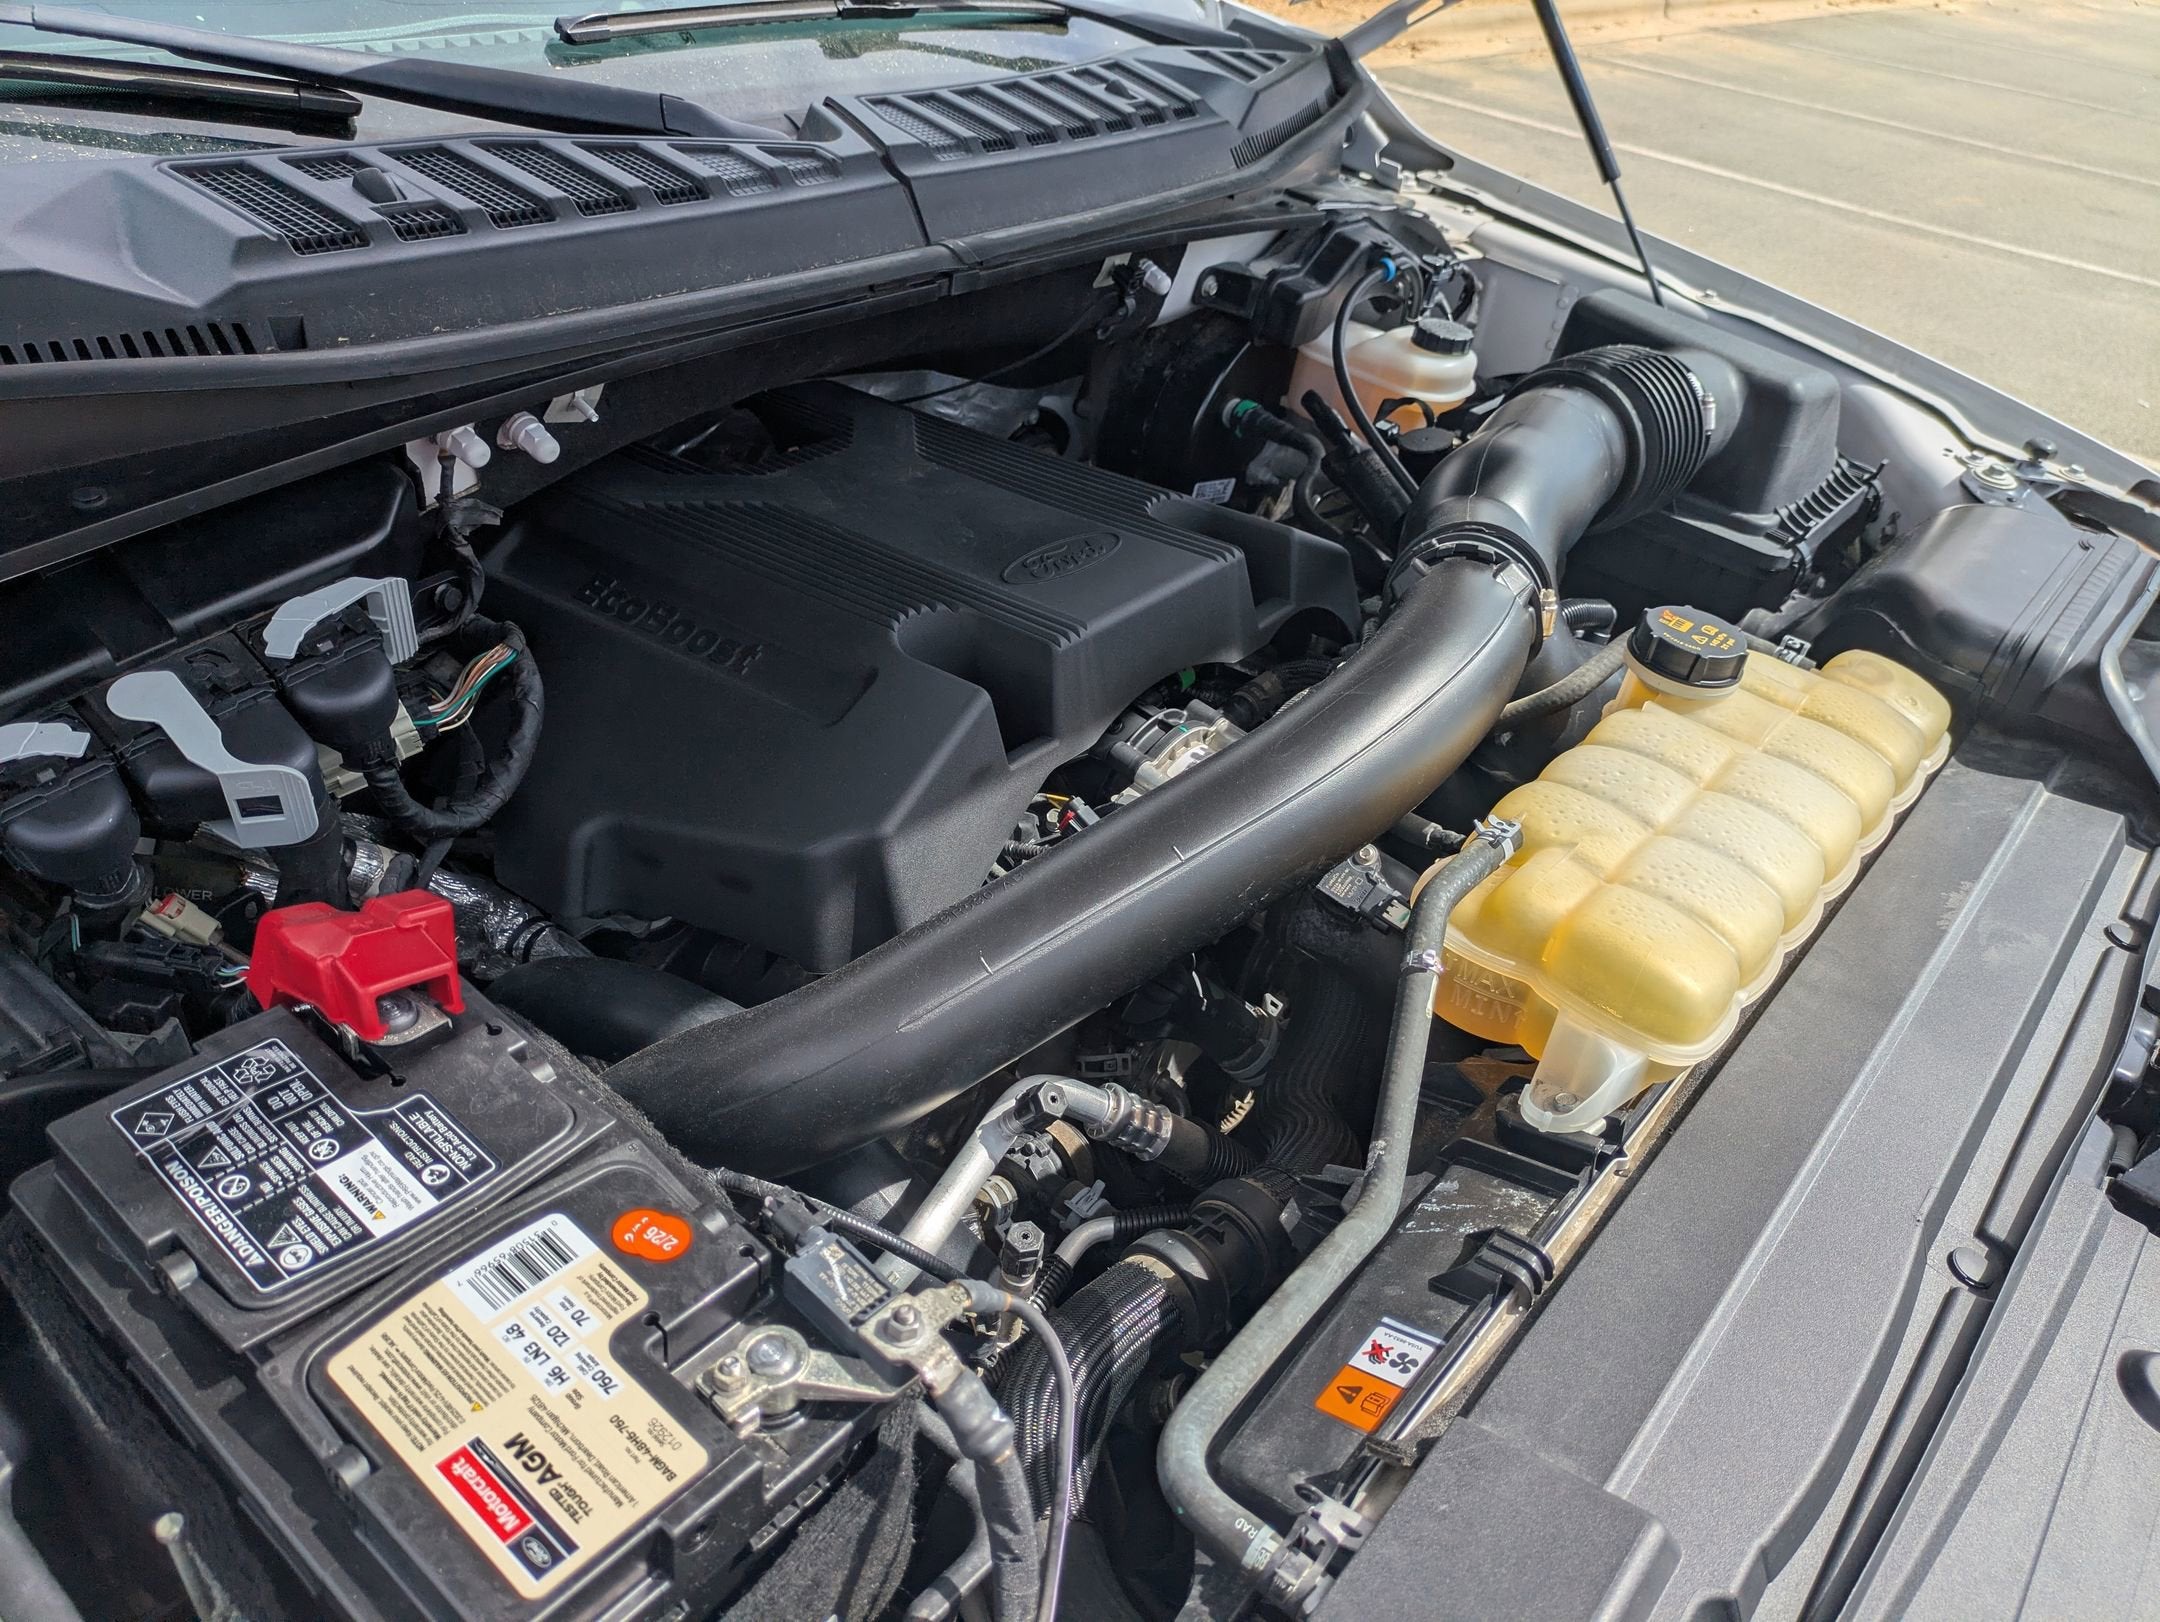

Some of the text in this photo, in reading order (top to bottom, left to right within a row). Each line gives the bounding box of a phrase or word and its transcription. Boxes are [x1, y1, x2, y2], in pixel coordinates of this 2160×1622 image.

[1022, 540, 1107, 578] Ford
[579, 580, 763, 675] EcoBoost
[1457, 961, 1515, 998] MAX
[1451, 985, 1511, 1023] MIN
[198, 1075, 230, 1106] GET MEDICAL
[212, 1075, 239, 1101] HELP FAST.
[277, 1087, 299, 1105] NOT
[287, 1077, 314, 1101] OPEN.
[164, 1094, 194, 1123] FLUSH EYES
[172, 1087, 204, 1118] IMMEDIATELY
[197, 1099, 213, 1114] WITH
[266, 1095, 284, 1110] DO
[231, 1112, 267, 1148] BLINDNESS OR
[257, 1123, 278, 1143] SEVERE
[284, 1120, 310, 1145] KEEP OUT
[301, 1119, 322, 1138] OF THE
[307, 1108, 334, 1132] REACH OF
[215, 1132, 245, 1160] SULFURIC
[227, 1126, 256, 1154] CAN CAUSE
[387, 1120, 433, 1163] INSTRUCTIONS.
[408, 1111, 471, 1169] NON-SPILLABLE
[424, 1109, 477, 1160] Lead Acid Battery
[258, 1160, 282, 1182] SPARKS
[269, 1154, 293, 1177] FLAMES
[278, 1146, 304, 1171] SMOKING
[404, 1150, 424, 1168] READ
[258, 1180, 273, 1193] NO
[335, 1173, 378, 1214] WARNING:
[386, 1183, 403, 1198] hands
[164, 1159, 256, 1258] DANGER/POISON
[291, 1195, 342, 1246] EXPLOSIVE GASES
[297, 1183, 353, 1240] CAN CAUSE BLINDNESS
[332, 1204, 363, 1234] OR INJURY.
[288, 1214, 330, 1255] SHIELD EYES.
[643, 1226, 679, 1251] 2/26
[533, 1304, 552, 1323] Capacity
[570, 1307, 590, 1326] 70
[505, 1321, 527, 1342] 48
[545, 1323, 570, 1347] 120
[523, 1340, 551, 1366] LN3
[547, 1364, 570, 1386] H6
[590, 1368, 619, 1394] 760
[544, 1408, 571, 1435] Michigan
[646, 1416, 682, 1451] 012926
[502, 1429, 562, 1490] AGM
[526, 1404, 624, 1508] Manufactured for Ford Motor Company
[566, 1432, 596, 1462] Dearborn,
[608, 1413, 676, 1481] BAGM-48H6-760
[629, 1452, 640, 1464] Part
[591, 1458, 611, 1477] Road,
[448, 1455, 520, 1532] Motorcraft
[606, 1474, 636, 1504] American
[547, 1486, 584, 1525] TESTED
[1234, 1517, 1258, 1539] RAD
